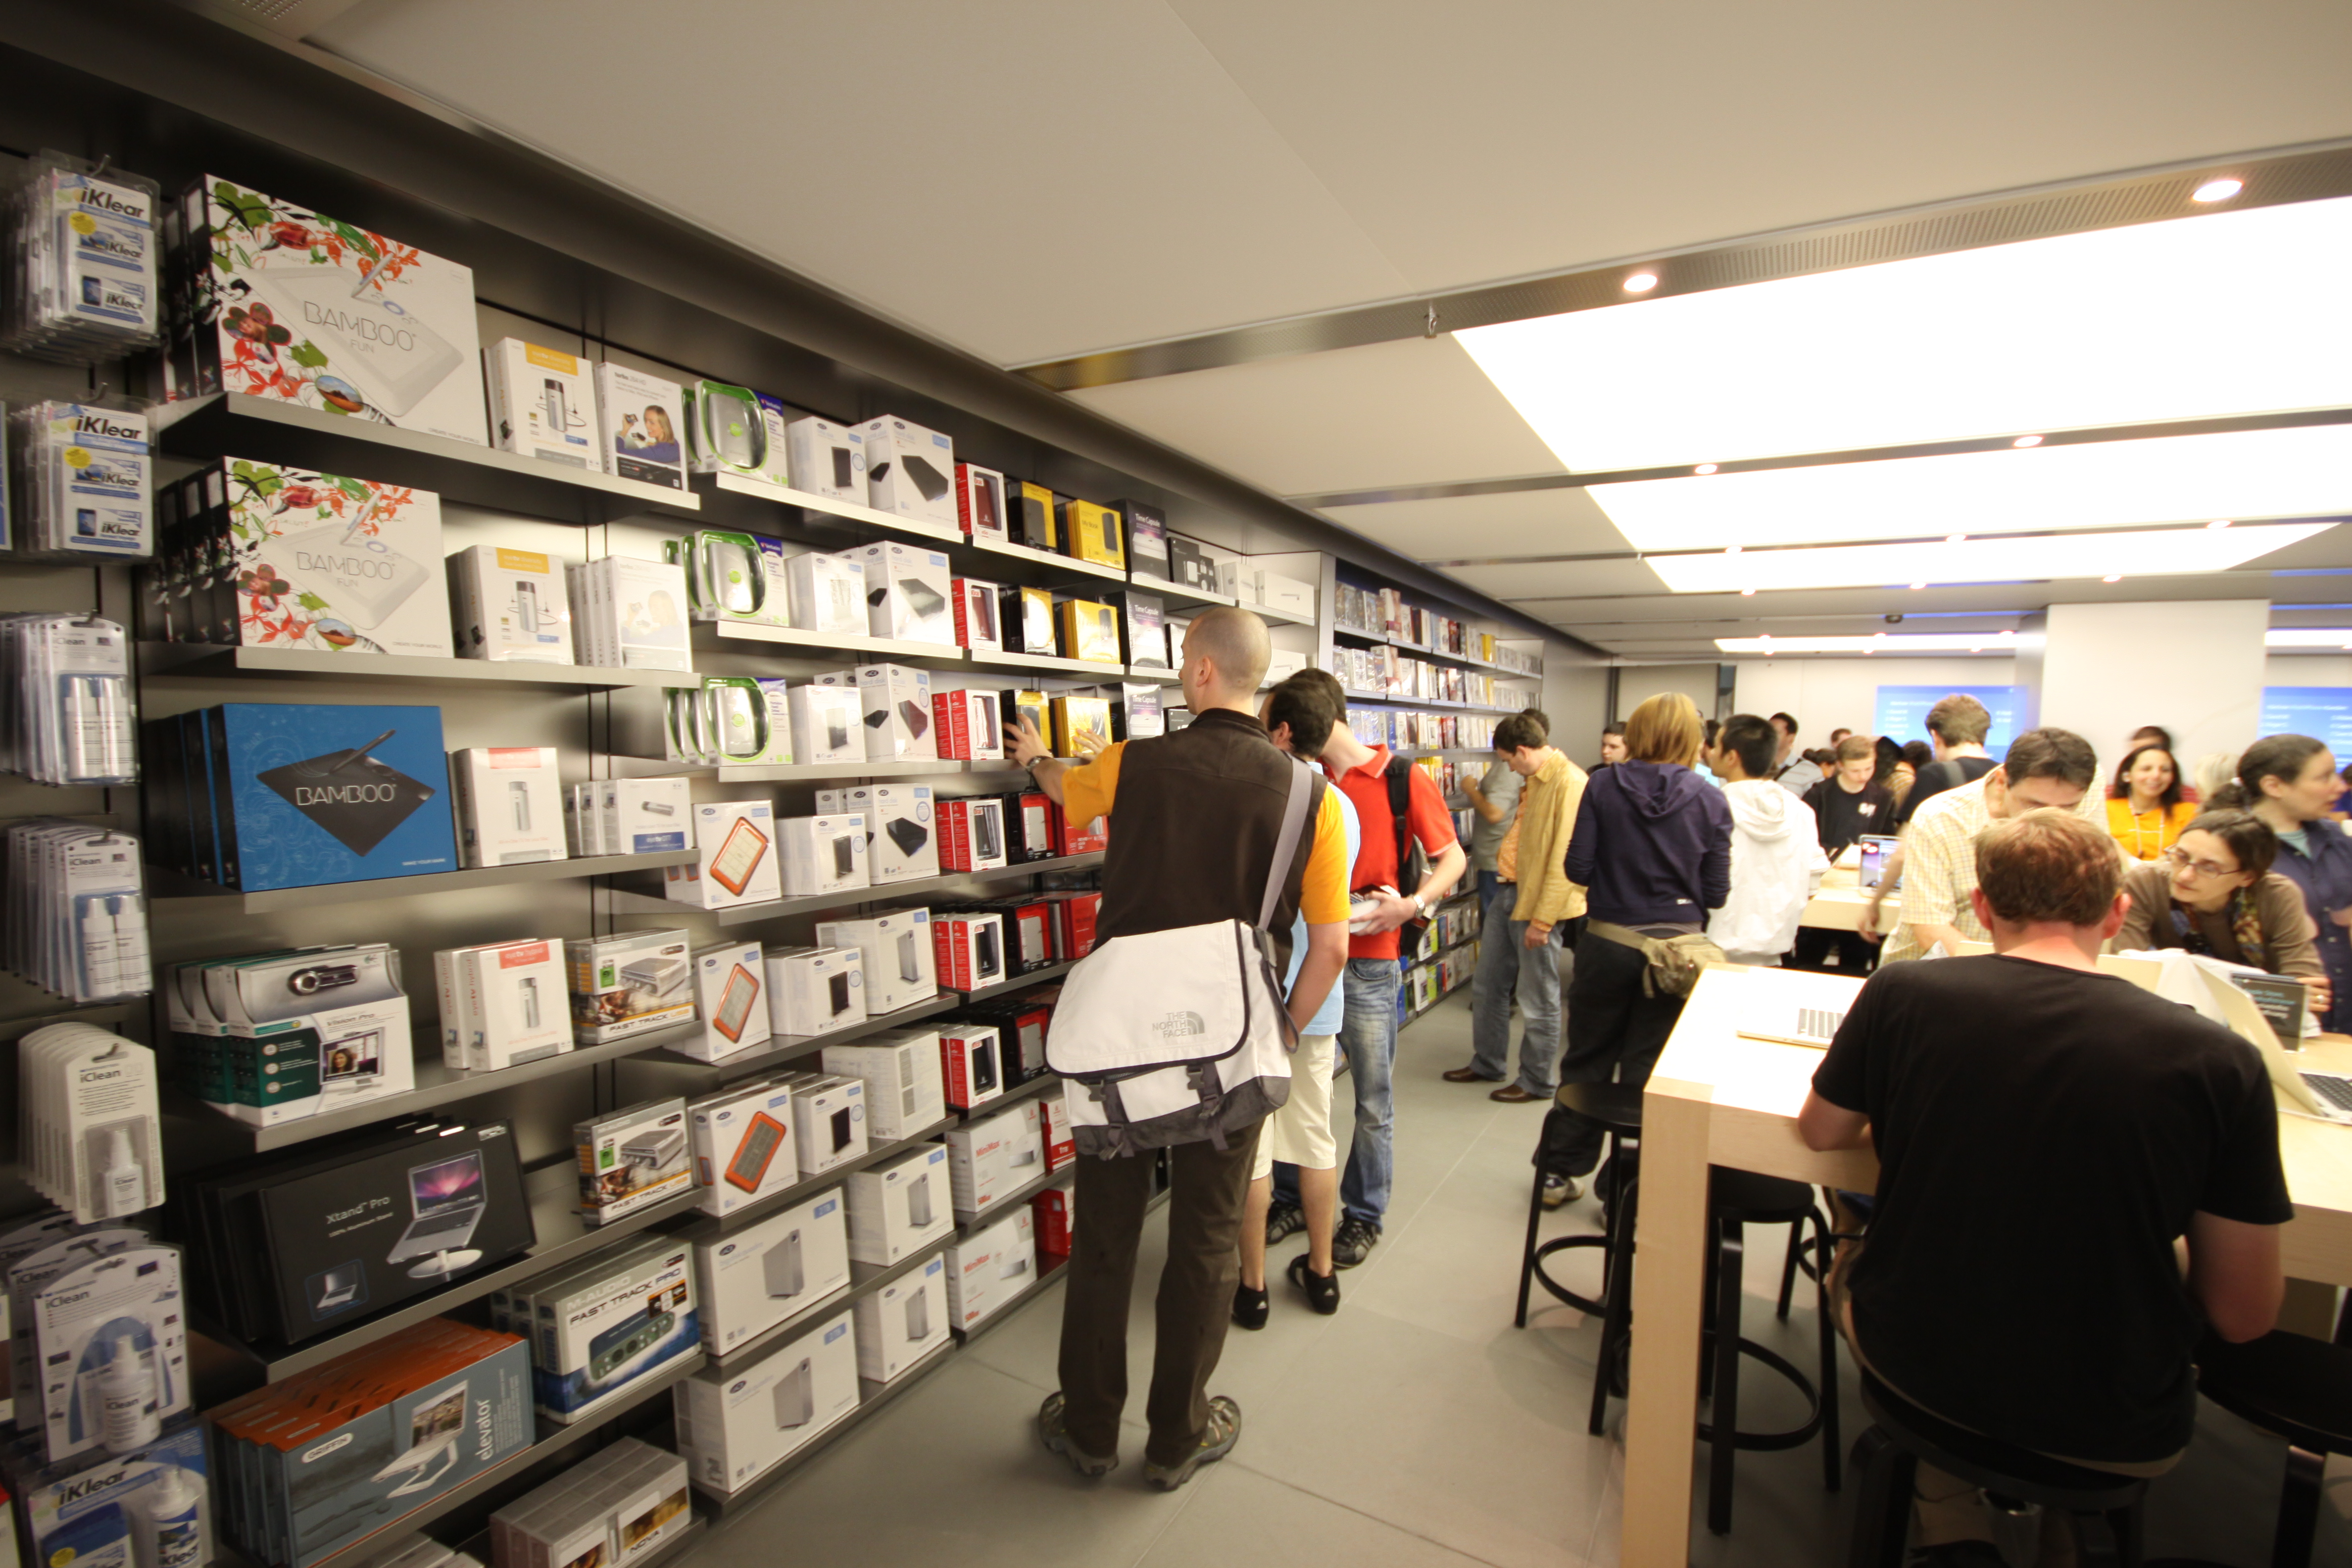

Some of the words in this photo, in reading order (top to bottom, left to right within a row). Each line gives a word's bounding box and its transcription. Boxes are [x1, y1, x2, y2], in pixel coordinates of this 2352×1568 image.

[80, 187, 144, 218] iKlear
[303, 300, 414, 351] BAMBOO
[76, 415, 142, 440] iKlear
[101, 472, 140, 487] iKlear
[101, 523, 140, 536] iKlear
[1135, 513, 1146, 525] Time
[1146, 516, 1161, 529] Capsule
[296, 551, 394, 580] BAMBOO
[337, 577, 359, 588] FUN
[1134, 604, 1145, 614] Time
[1145, 605, 1159, 617] Capsule
[1142, 695, 1157, 704] Capsule
[295, 784, 395, 806] BAMBOO
[609, 1021, 636, 1031] FAST
[637, 1013, 669, 1026] TRACK
[1152, 1019, 1188, 1031] NORTH
[1166, 1011, 1186, 1021] THE
[1163, 1027, 1188, 1038] FACE
[80, 1069, 121, 1083] iClean
[326, 1204, 365, 1224] Xtand
[370, 1196, 391, 1210] Pro
[46, 1290, 90, 1310] iClean
[570, 1302, 607, 1325] FAST
[610, 1279, 653, 1306] TRACK
[655, 1268, 681, 1285] PRO
[475, 1397, 493, 1461] elevator
[307, 1435, 349, 1460] GRIFFIN
[58, 1470, 128, 1507] iKlear
